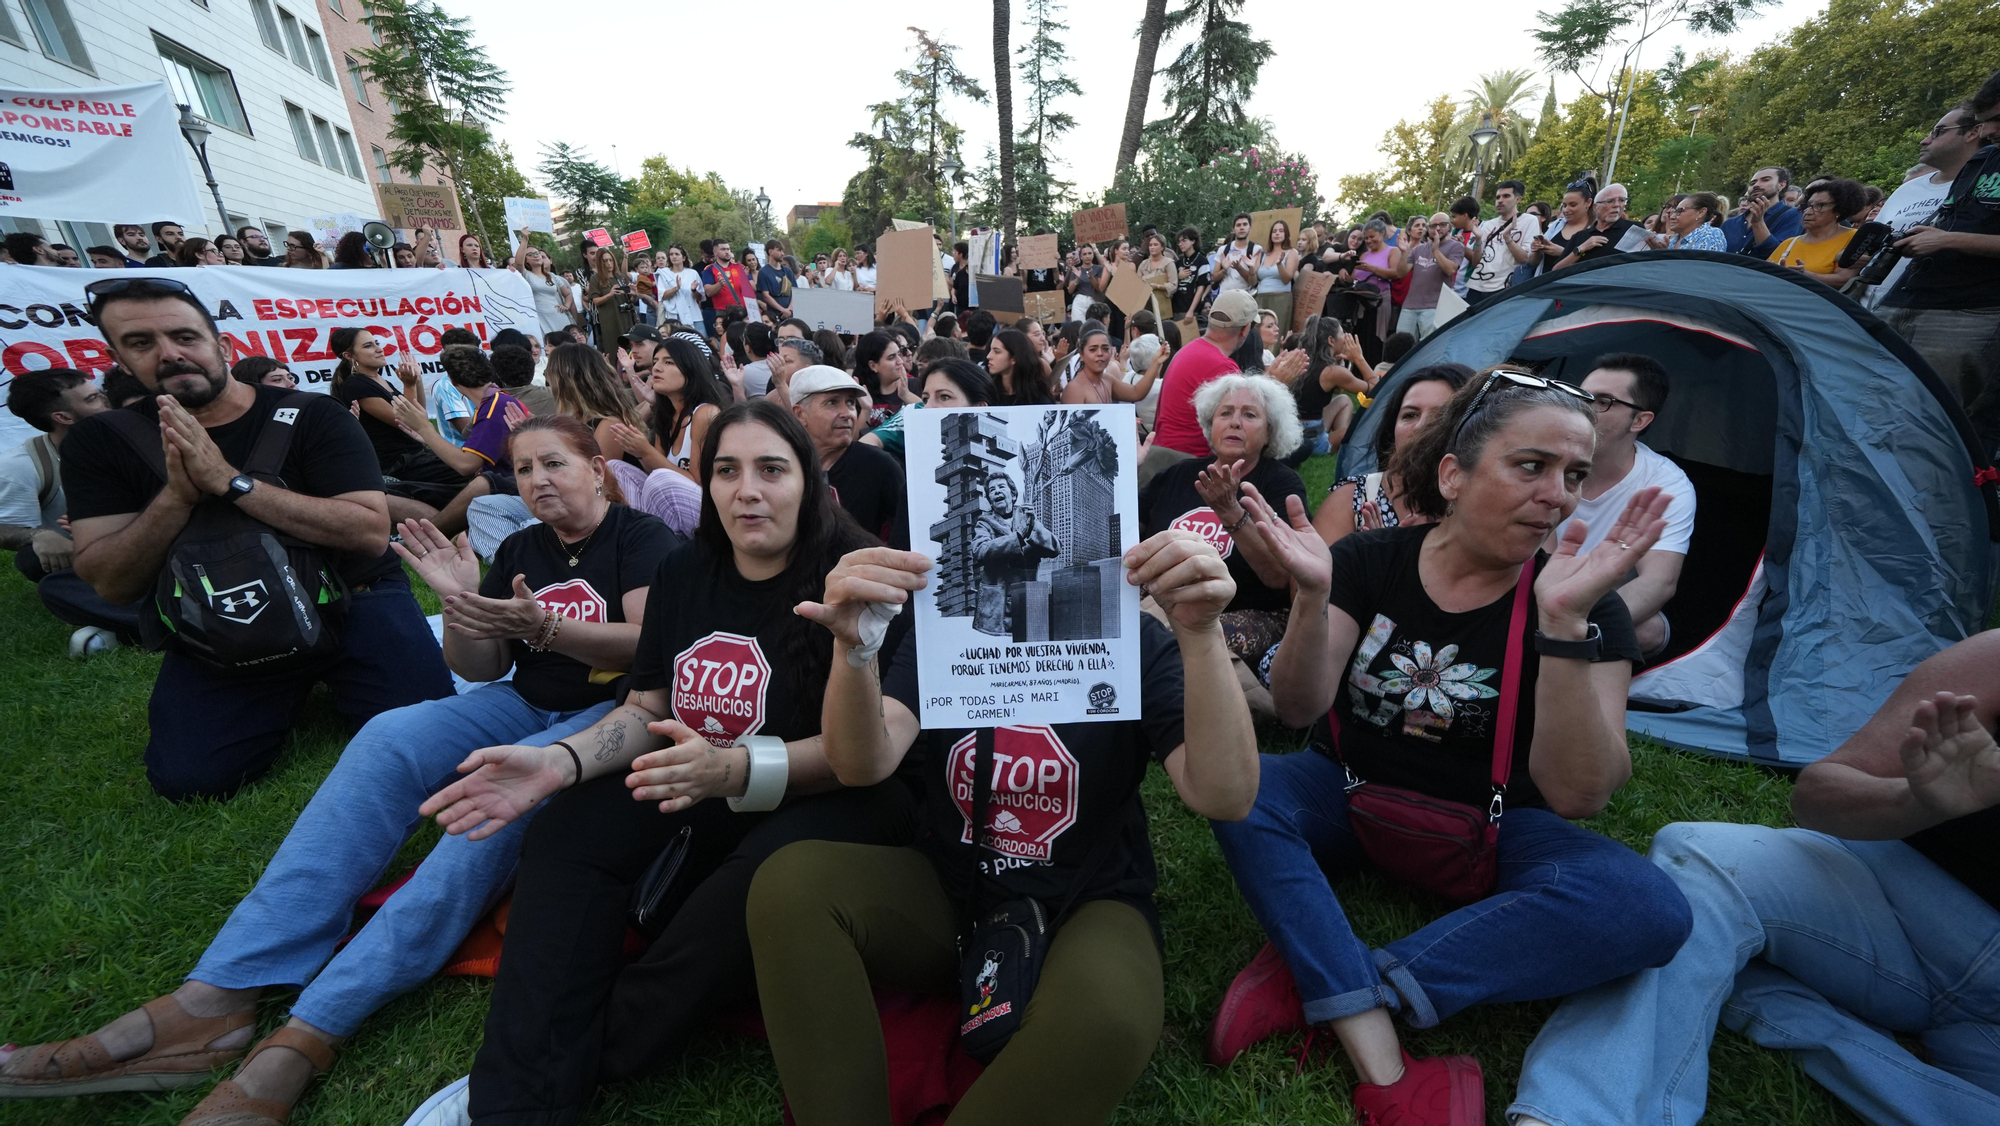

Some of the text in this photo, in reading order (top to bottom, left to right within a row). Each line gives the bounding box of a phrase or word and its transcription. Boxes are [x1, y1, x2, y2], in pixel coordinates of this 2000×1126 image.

[12, 97, 137, 118] CULPABLE
[416, 198, 445, 209] CASAS
[1895, 198, 1943, 217] AUTHEN
[407, 215, 456, 230] QUEDAMOS
[1075, 213, 1087, 227] LA
[1098, 219, 1125, 233] DERECHO
[211, 299, 244, 321] A
[252, 291, 482, 321] ESPECULACIÓN
[305, 368, 333, 384] DE
[1005, 646, 1023, 659] POR
[1025, 644, 1062, 658] VUESTRA
[951, 663, 986, 677] PORQUE
[988, 660, 1031, 675] TENEMOS
[1035, 658, 1074, 673] DERECHO
[1077, 659, 1085, 671] A
[680, 657, 759, 698] STOP
[1037, 678, 1053, 687] AÑOS
[926, 691, 1060, 710] ¡POR TODAS LAS MARI
[1090, 687, 1113, 702] STOP
[677, 691, 753, 718] DESAHUCIOS
[967, 707, 1016, 720] CARMEN!
[957, 783, 1063, 814] DEAHUCIOS
[986, 835, 1046, 858] CÓRDOBA
[982, 1000, 1012, 1023] MOUSE
